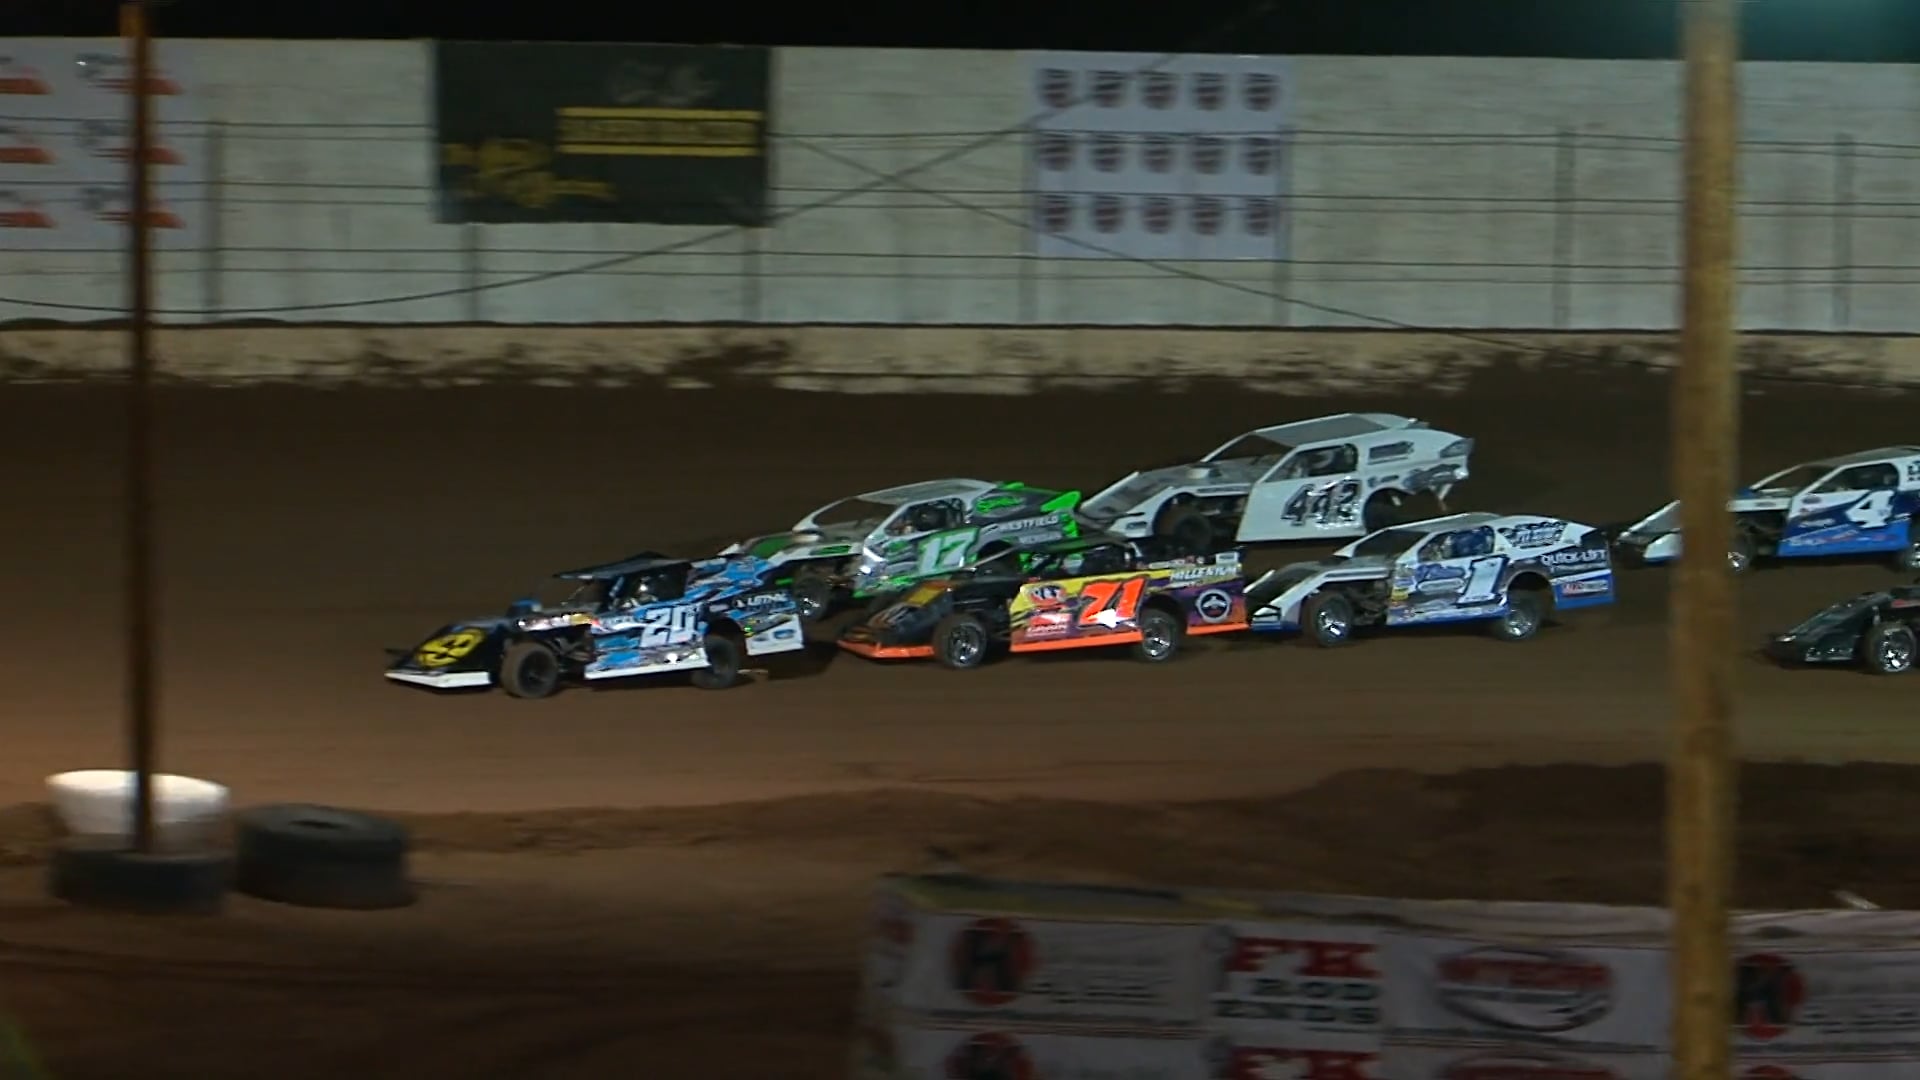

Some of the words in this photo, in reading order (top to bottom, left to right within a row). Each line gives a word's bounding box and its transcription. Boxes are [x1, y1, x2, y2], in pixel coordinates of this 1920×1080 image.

[1846, 490, 1894, 529] 4
[918, 530, 975, 575] 17
[1457, 556, 1507, 605] 1
